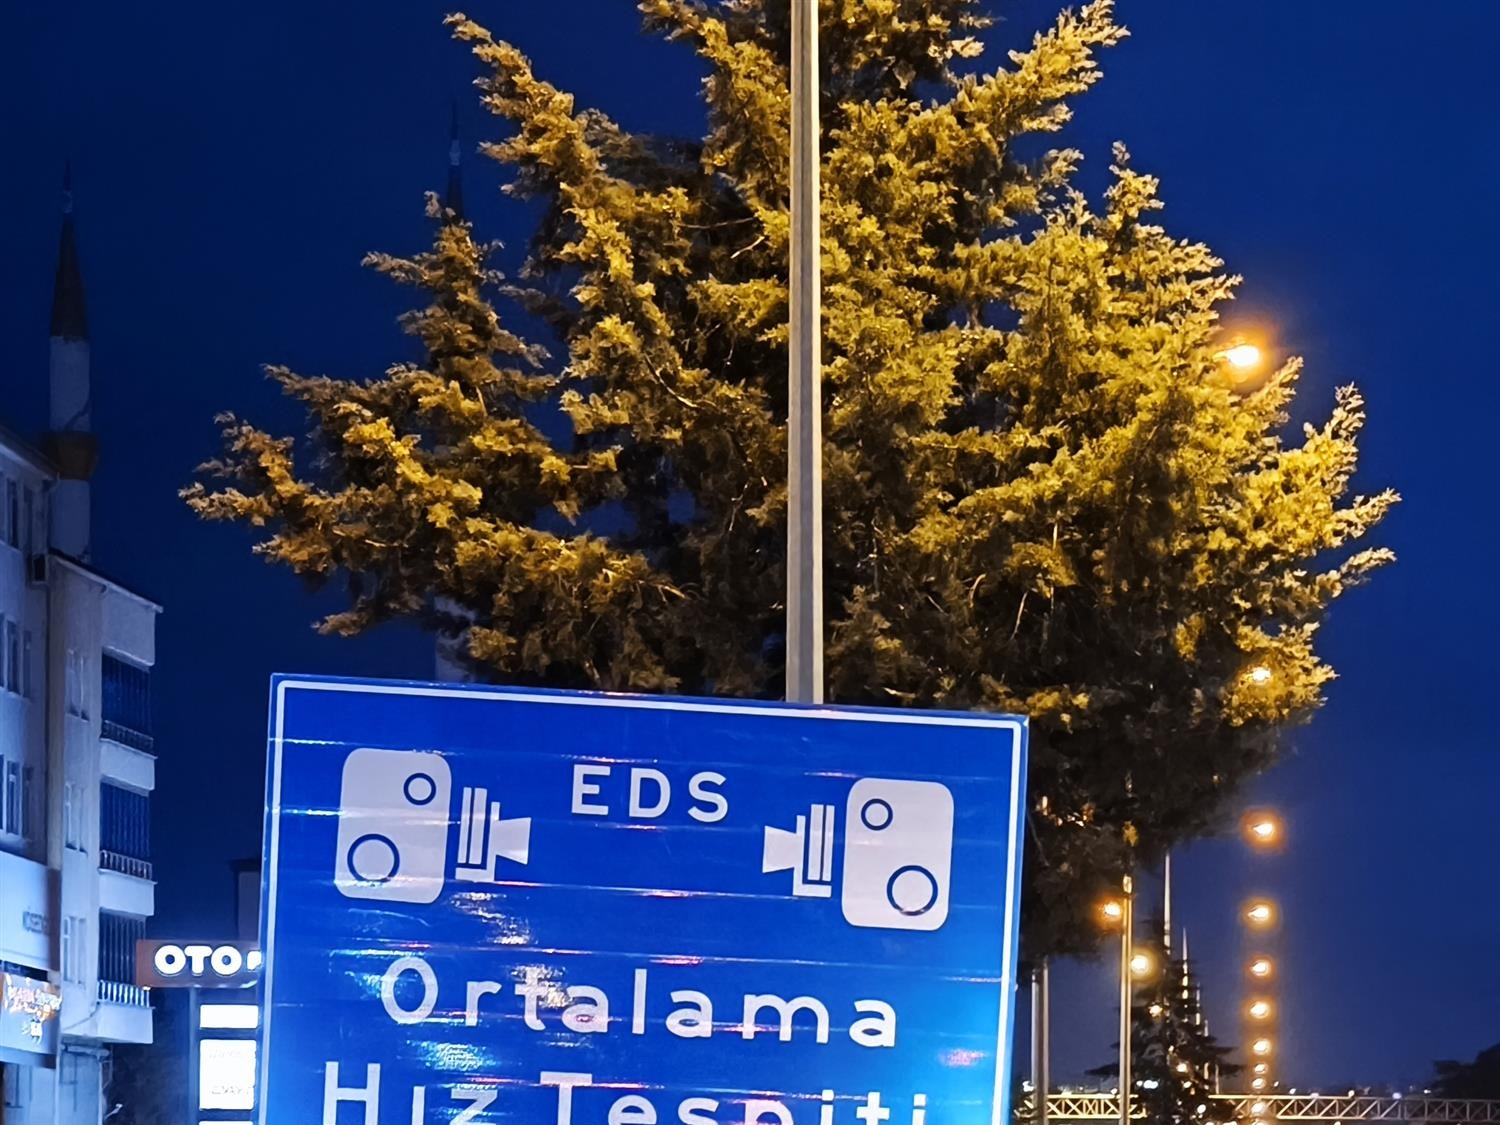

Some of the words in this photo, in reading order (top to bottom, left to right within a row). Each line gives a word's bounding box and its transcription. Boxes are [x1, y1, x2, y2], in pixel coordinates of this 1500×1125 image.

[571, 764, 730, 823] EDS
[154, 944, 242, 975] OTO
[380, 957, 898, 1048] Ortalama
